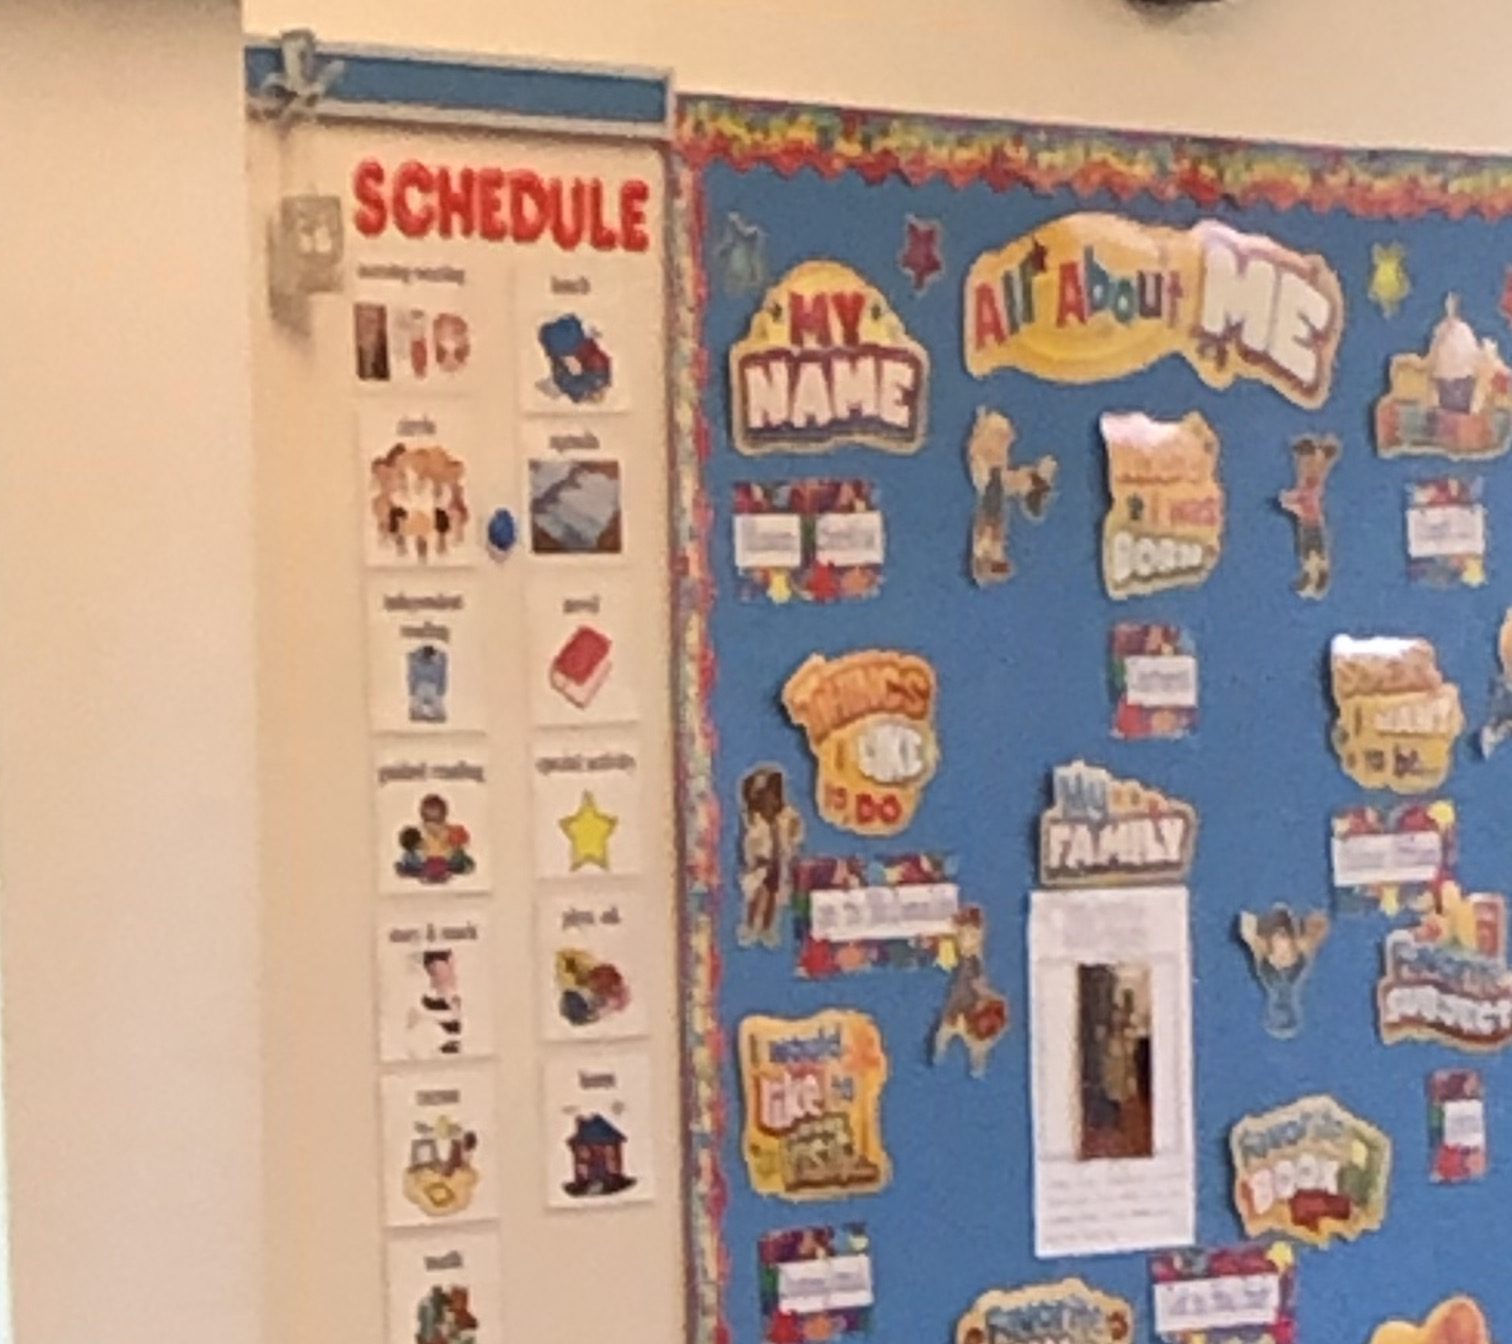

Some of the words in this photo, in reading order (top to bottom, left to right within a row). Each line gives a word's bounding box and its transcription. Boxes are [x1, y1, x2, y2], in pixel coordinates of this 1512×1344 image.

[353, 158, 651, 253] SCHEDULE
[790, 291, 867, 347] MY
[1200, 246, 1331, 385] ME
[744, 357, 916, 430] NAME
[1049, 817, 1184, 869] FAMILY
